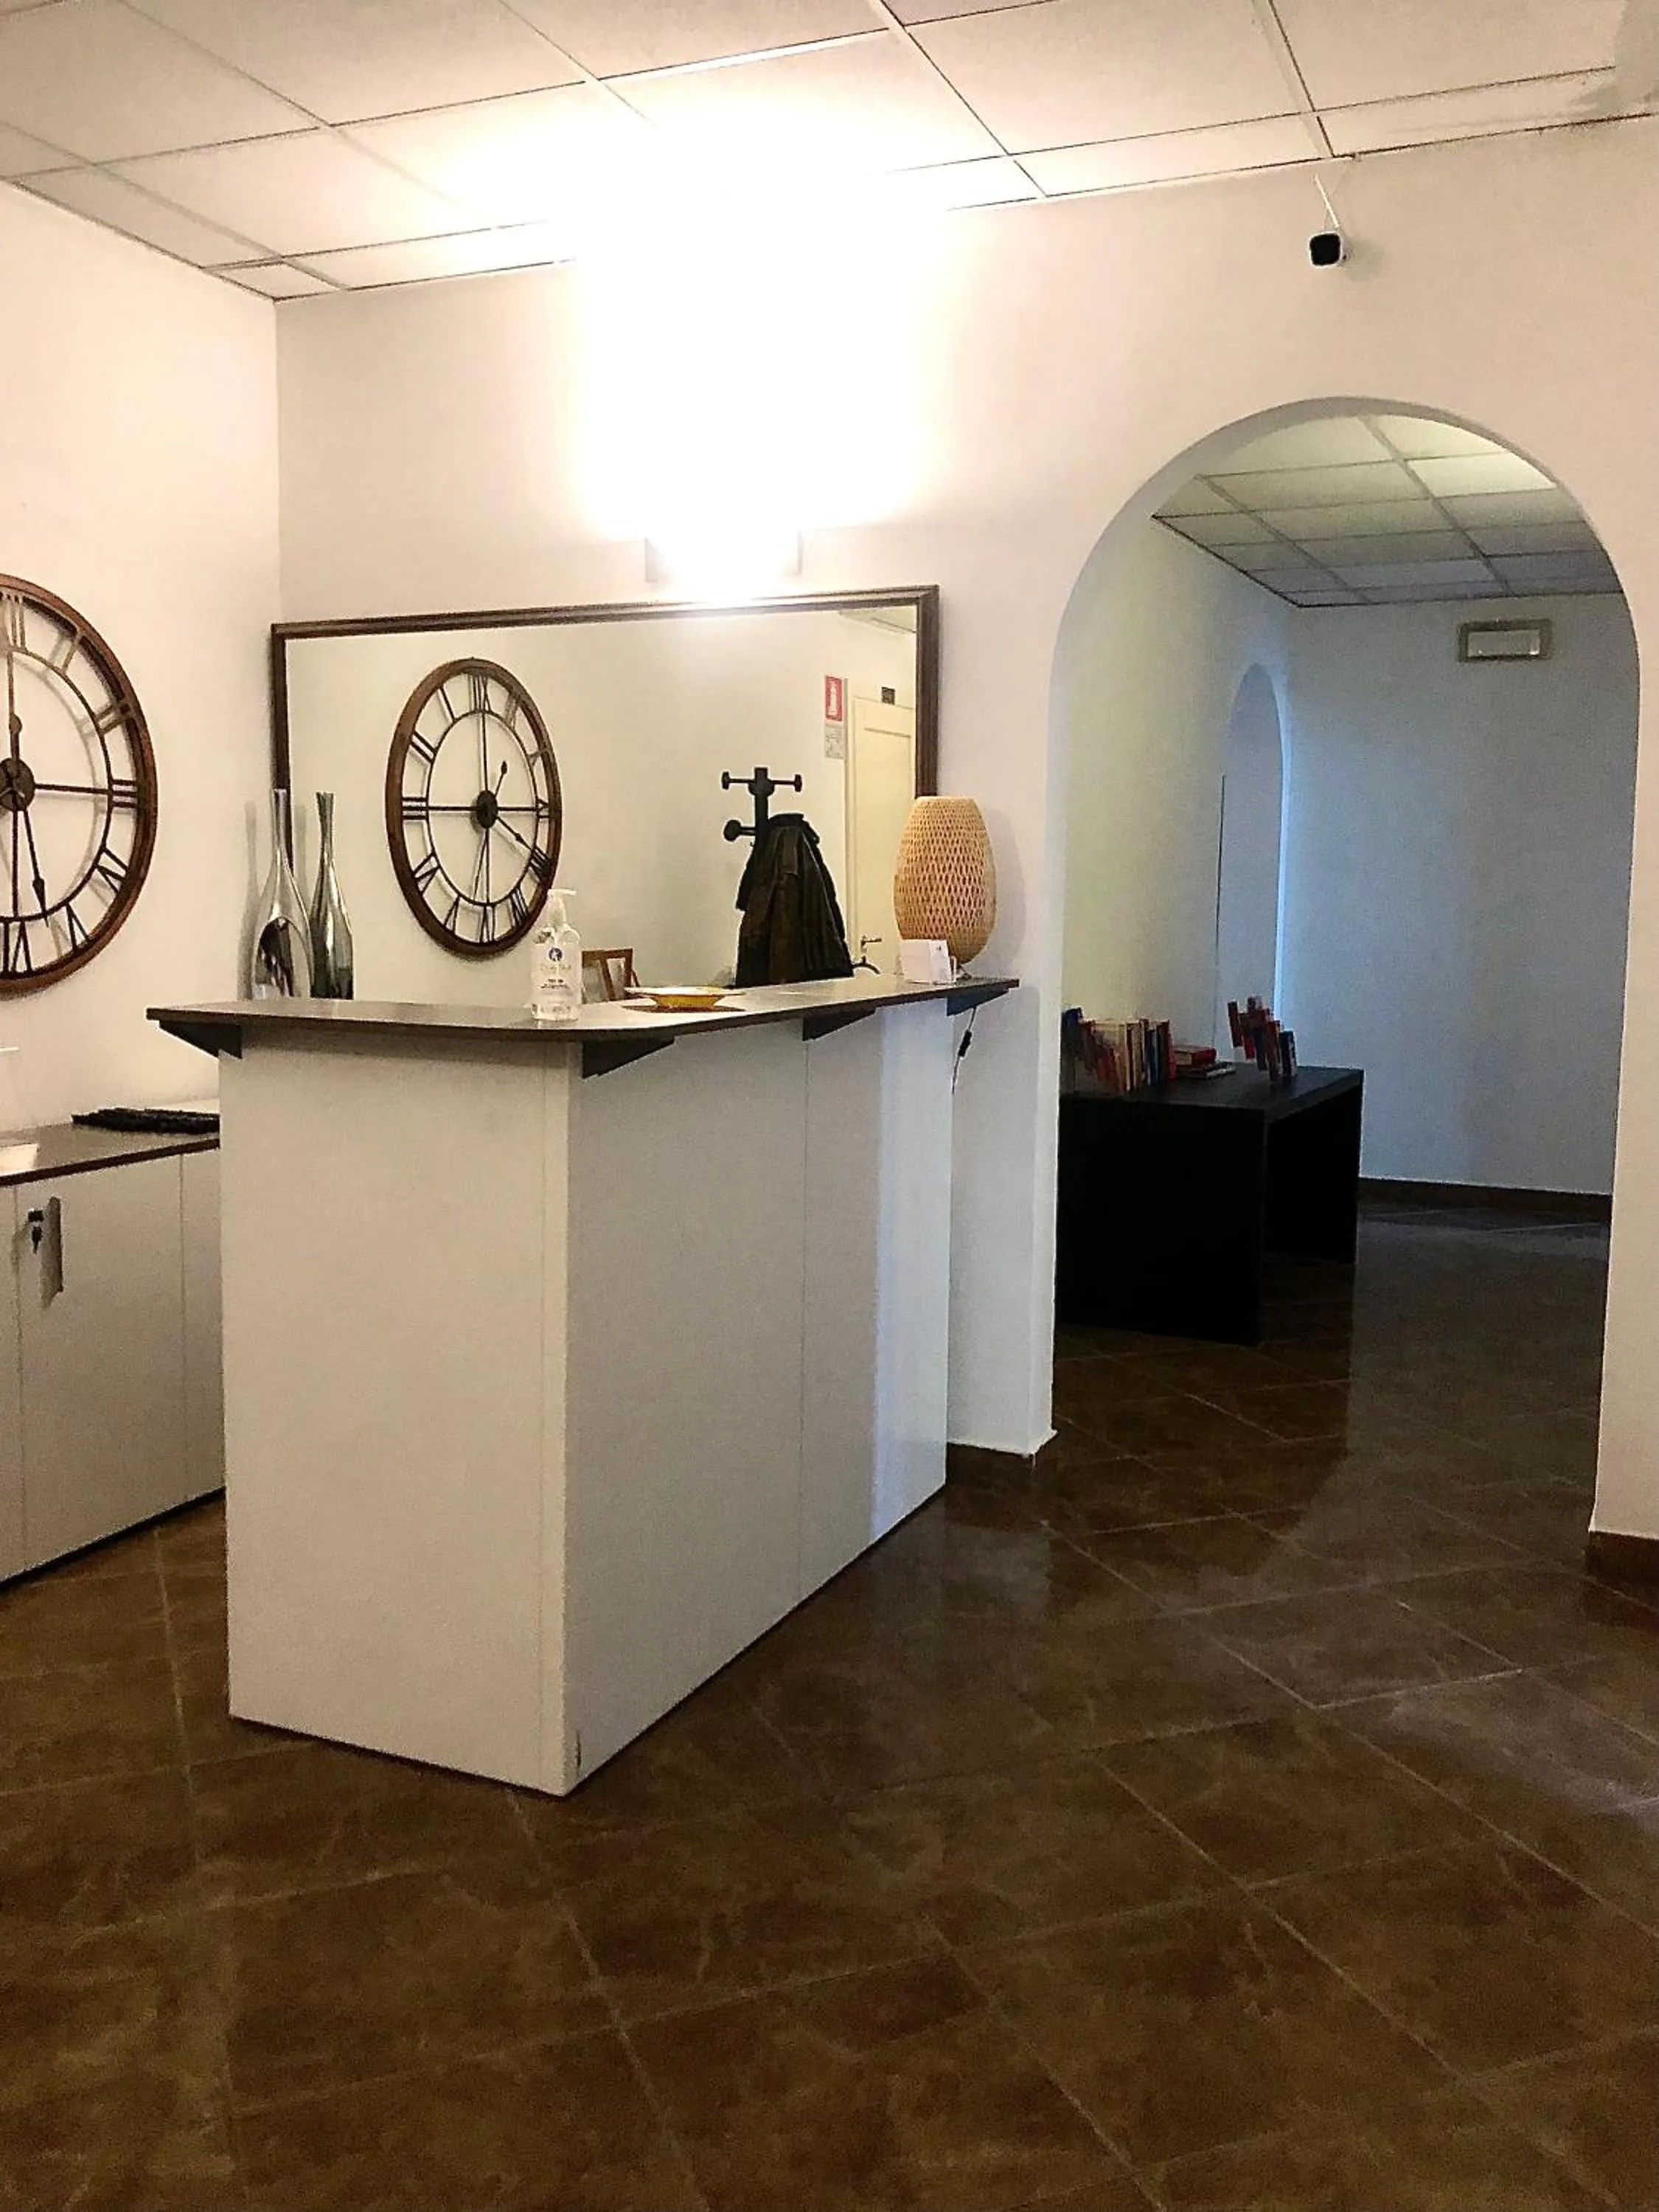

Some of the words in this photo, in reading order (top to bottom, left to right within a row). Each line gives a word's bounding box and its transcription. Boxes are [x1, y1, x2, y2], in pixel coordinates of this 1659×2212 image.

[0, 594, 27, 650] II
[111, 779, 139, 809] III
[65, 902, 91, 950] V
